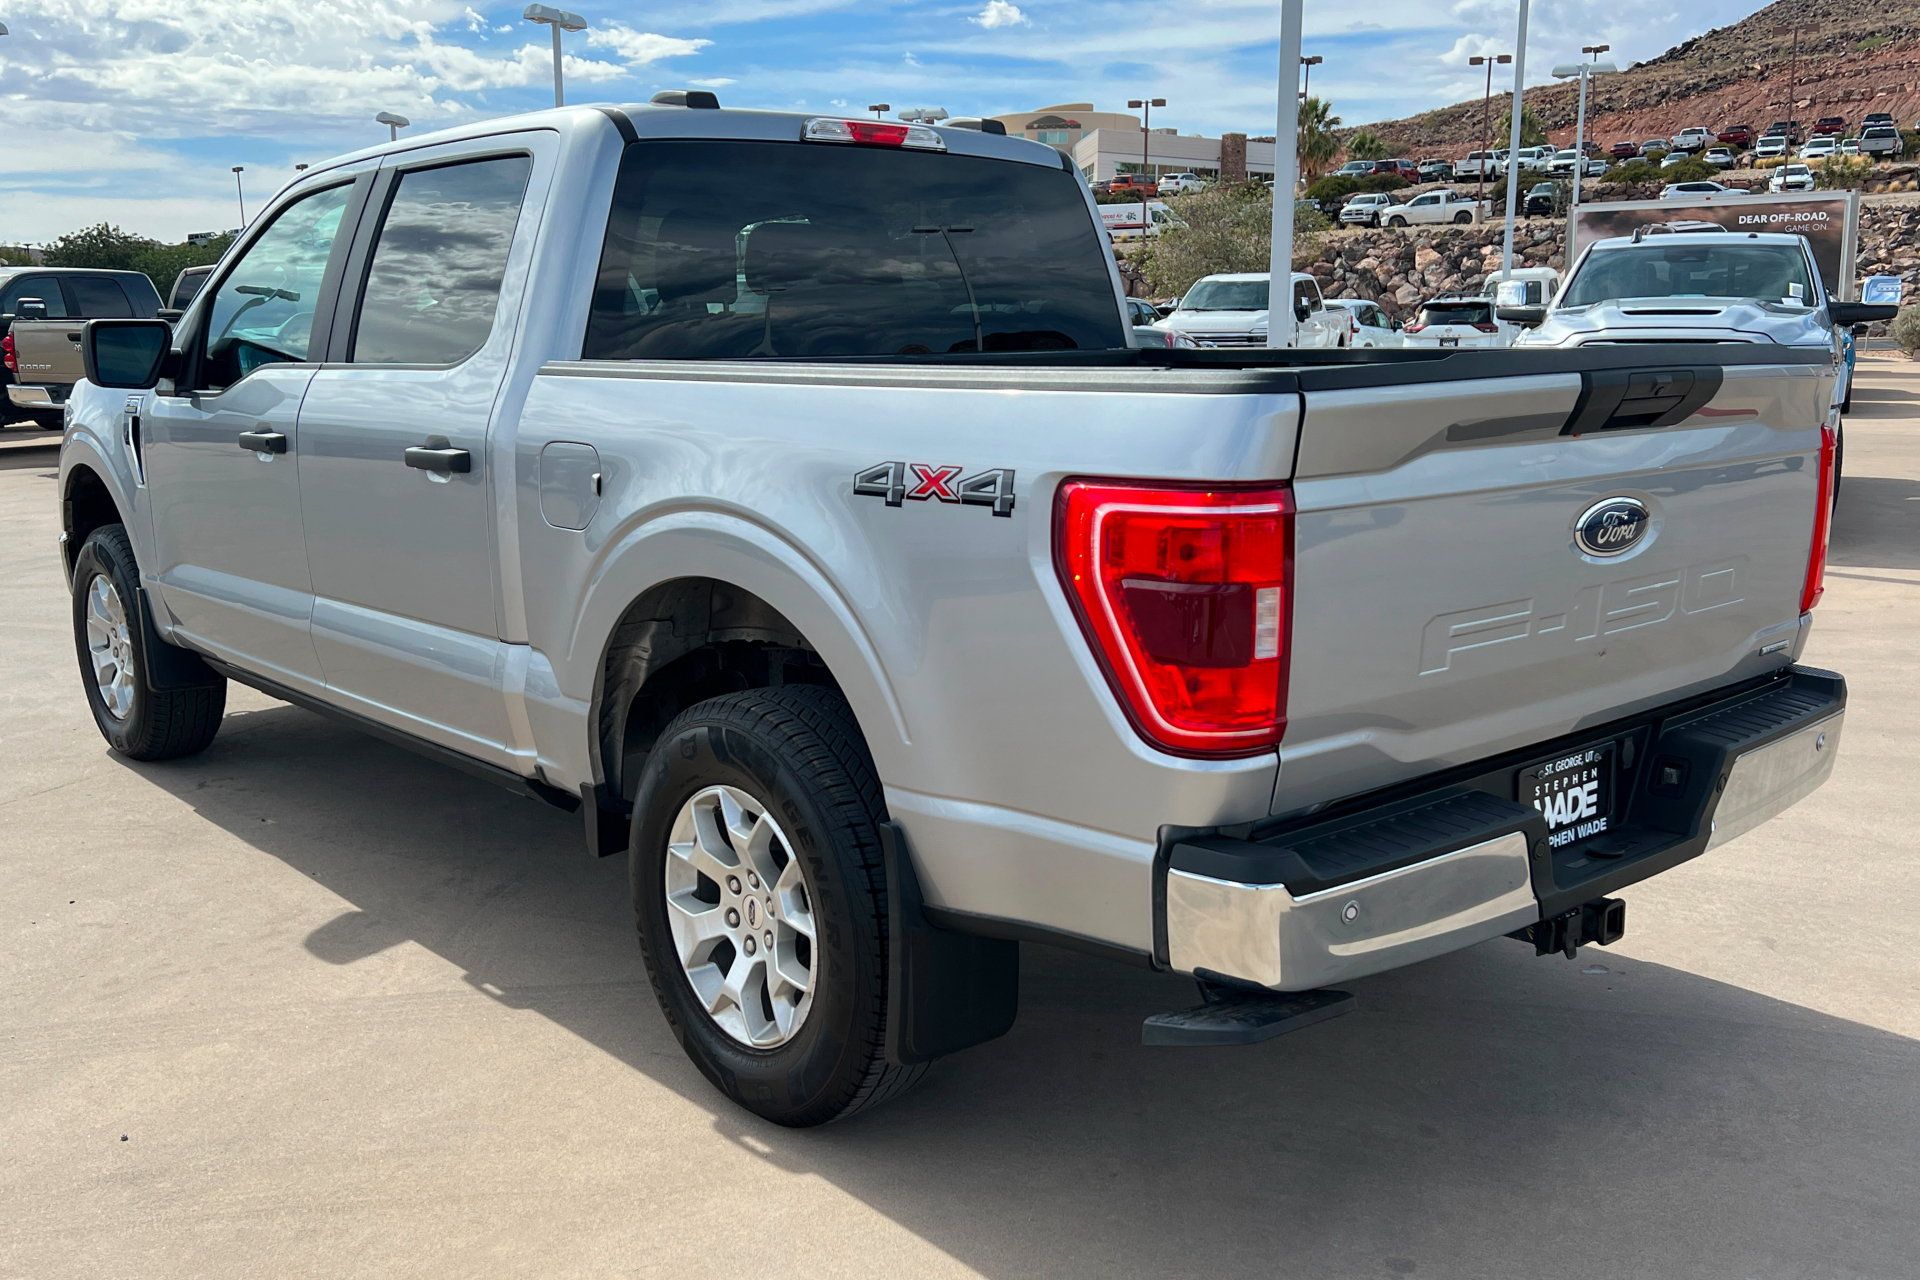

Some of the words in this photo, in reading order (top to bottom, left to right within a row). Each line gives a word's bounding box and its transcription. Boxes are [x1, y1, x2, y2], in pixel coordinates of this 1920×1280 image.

[1738, 214, 1768, 225] DEAR
[1769, 211, 1830, 223] OFF-ROAD,
[1784, 223, 1810, 233] GAME
[1597, 510, 1637, 544] Ford
[1418, 554, 1747, 676] F-150
[1544, 763, 1554, 776] ST.
[1555, 754, 1584, 772] GEORGE,
[1585, 750, 1594, 763] UT
[1535, 767, 1598, 796] STEPHEN
[1533, 780, 1598, 830] WADE
[1549, 828, 1575, 848] PHEN
[1577, 817, 1607, 839] WADE
